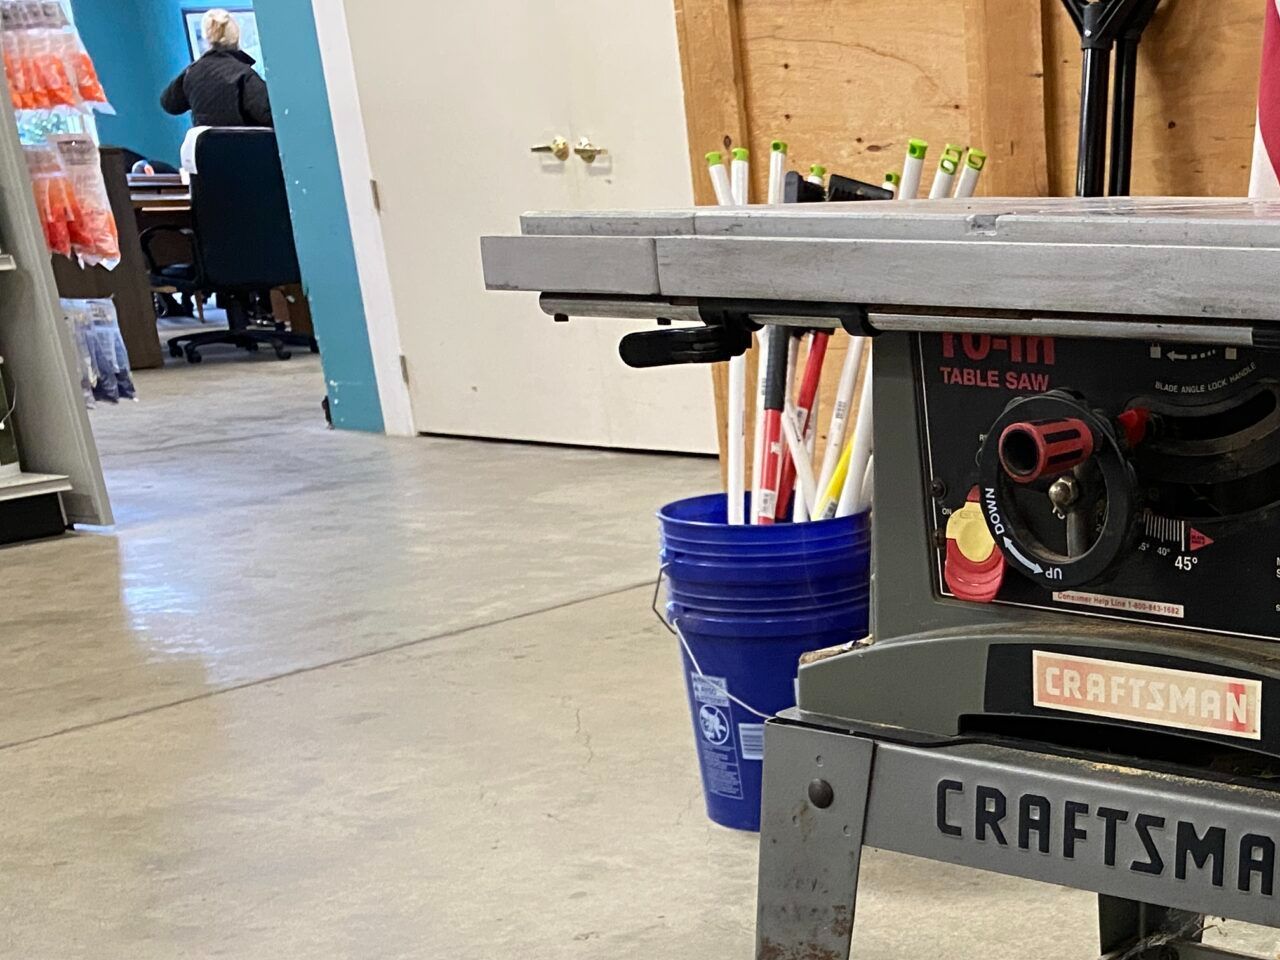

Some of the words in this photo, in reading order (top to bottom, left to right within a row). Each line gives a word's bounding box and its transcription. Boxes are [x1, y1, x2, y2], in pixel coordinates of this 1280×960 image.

[939, 366, 1000, 388] TABLE
[1005, 371, 1049, 391] SAW
[1155, 381, 1178, 393] BLADE
[1181, 384, 1206, 394] ANGLE
[1207, 378, 1228, 391] LOCK
[1229, 361, 1257, 384] HANDLE
[984, 487, 1005, 535] DOWN
[1045, 567, 1063, 581] UP
[1174, 555, 1198, 571] 45°
[1057, 592, 1092, 603] Consumer
[1094, 597, 1109, 607] Help
[1111, 598, 1126, 608] Line
[1045, 666, 1247, 724] CRAFTSMAN
